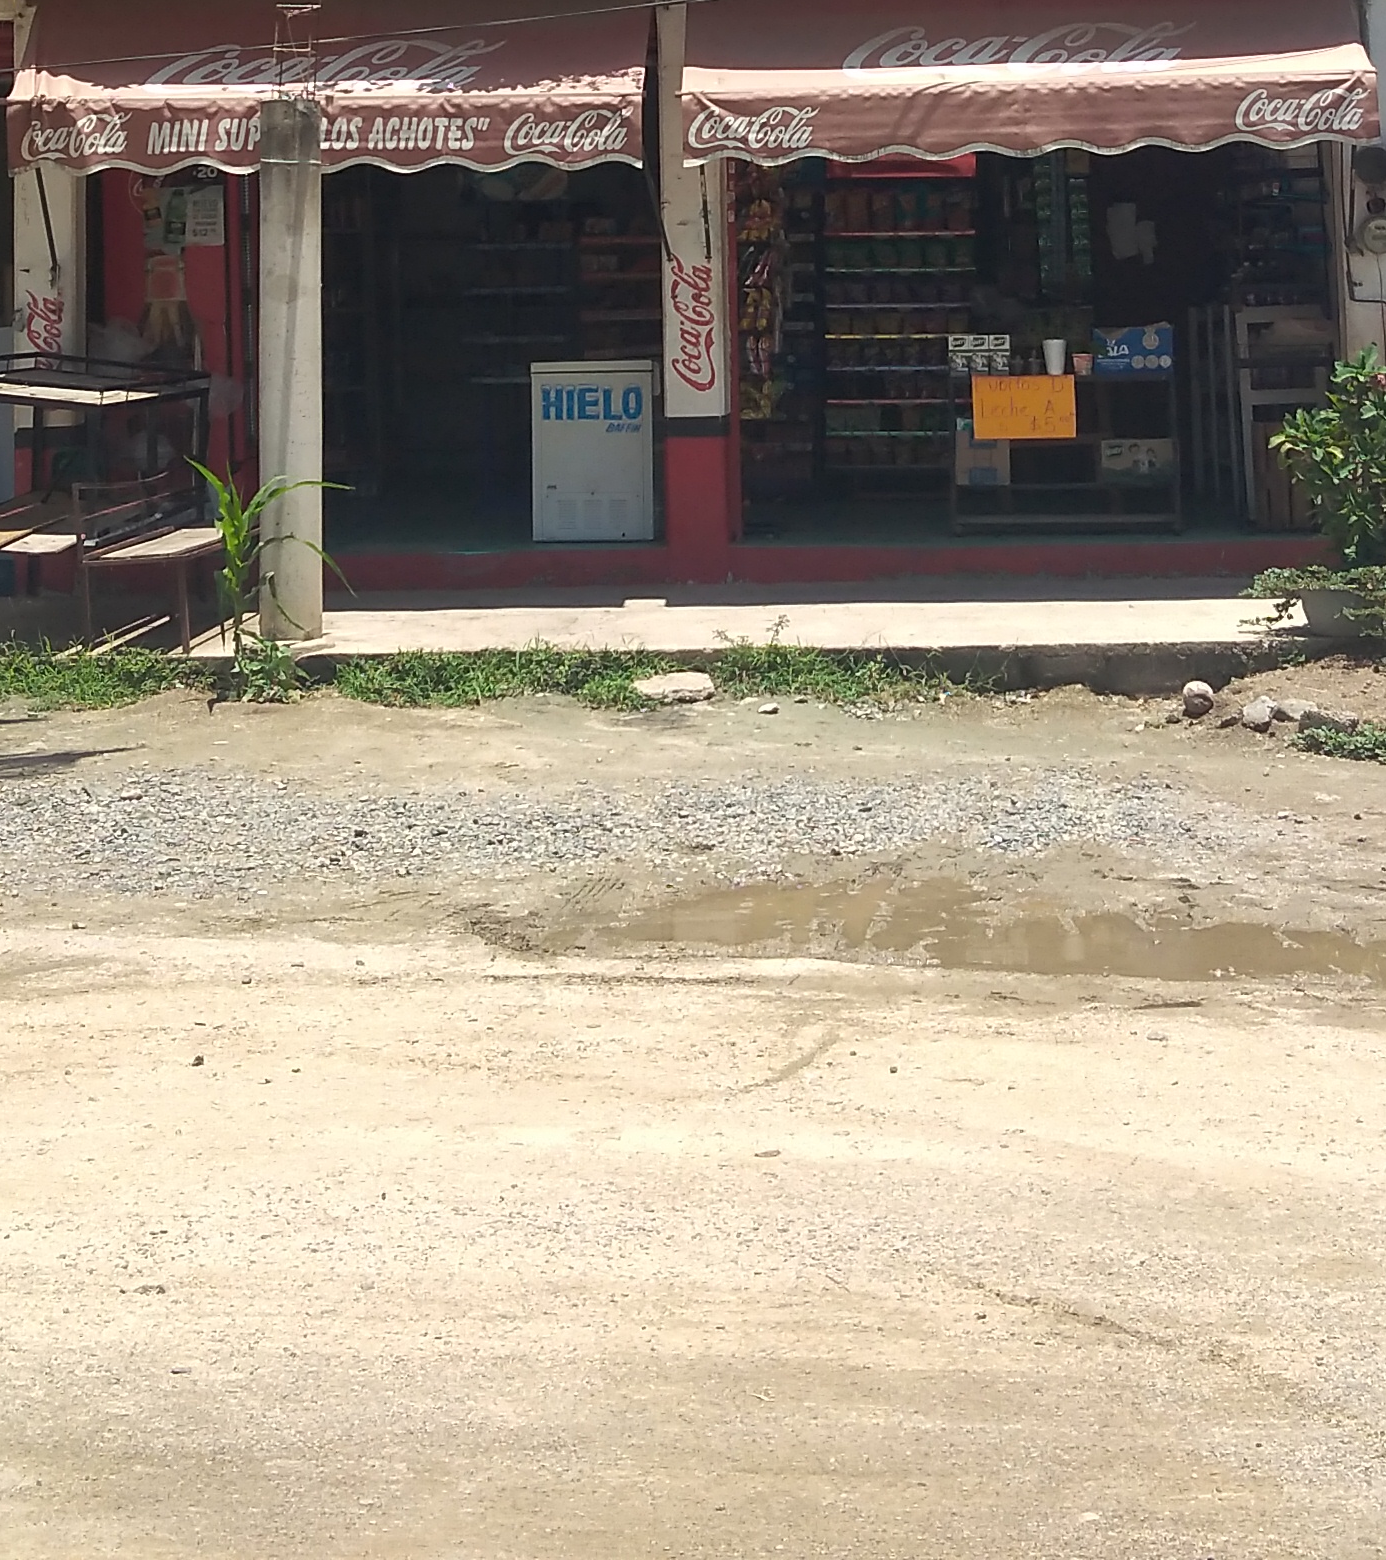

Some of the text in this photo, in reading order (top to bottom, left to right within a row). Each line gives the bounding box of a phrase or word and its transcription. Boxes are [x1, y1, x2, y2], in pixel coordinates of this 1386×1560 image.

[842, 21, 1196, 79] Coca-Cola
[688, 106, 820, 149] Coca-Cola
[1235, 88, 1371, 131] Coca-Cola
[21, 112, 132, 161] Coca-Cola
[146, 119, 209, 155] MINI
[215, 117, 261, 152] SUP
[320, 117, 363, 150] LOS
[504, 109, 634, 155] Coca-Cola
[670, 252, 716, 392] Coca-Cola
[541, 383, 644, 421] HIELO
